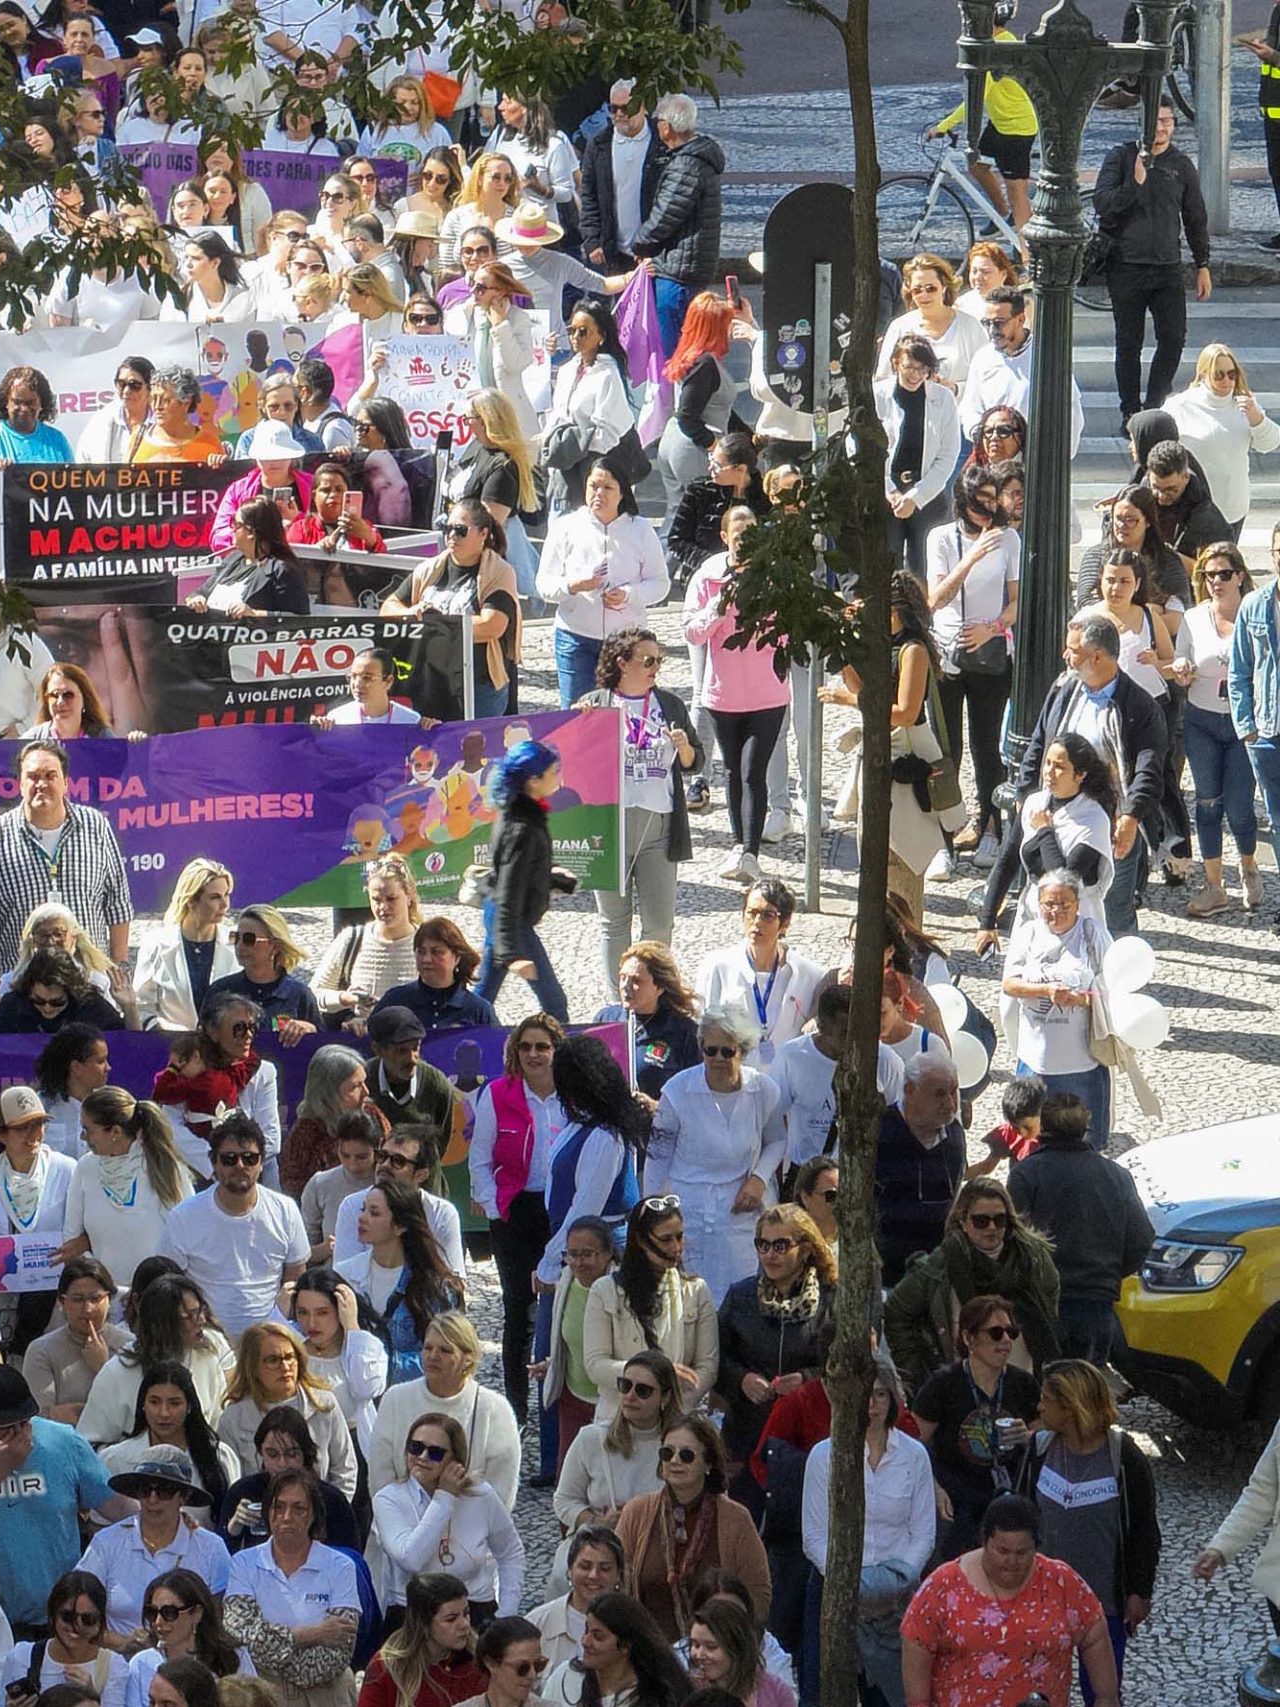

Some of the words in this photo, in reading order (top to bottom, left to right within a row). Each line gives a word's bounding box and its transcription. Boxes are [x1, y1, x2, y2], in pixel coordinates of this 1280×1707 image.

[166, 154, 193, 171] DAS
[29, 469, 107, 492] QUEM
[118, 469, 183, 488] BATE
[29, 497, 74, 523] NA
[87, 489, 218, 520] MULHER
[33, 565, 47, 580] A
[52, 556, 138, 579] FAMÍLIA
[167, 623, 268, 645] QUATRO
[275, 623, 375, 642] BARRAS
[383, 623, 424, 638] DIZ
[255, 639, 356, 678] NÃO
[238, 684, 312, 704] VIOLÊNCIA
[318, 685, 352, 697] CONT
[98, 775, 147, 801] DA
[118, 793, 315, 830] MULHERES!
[131, 853, 165, 872] 190
